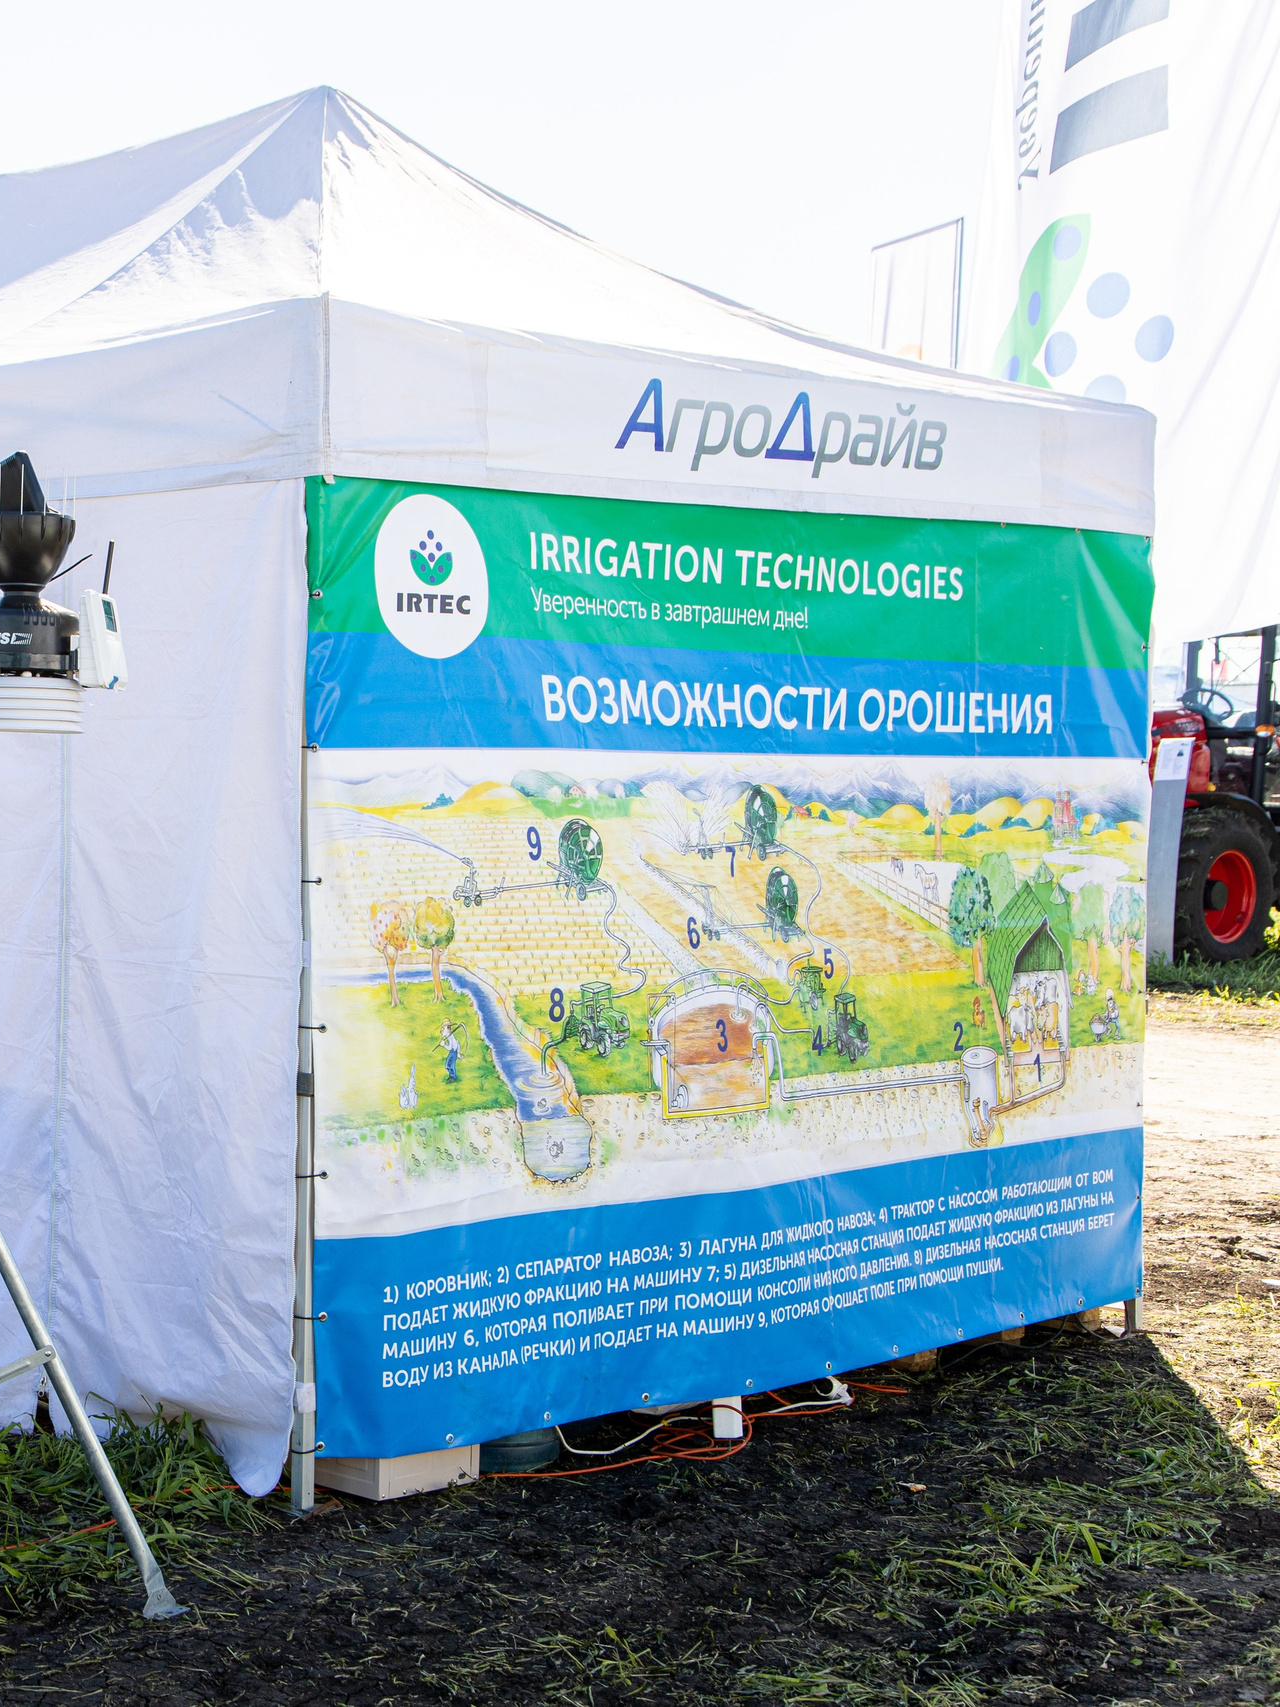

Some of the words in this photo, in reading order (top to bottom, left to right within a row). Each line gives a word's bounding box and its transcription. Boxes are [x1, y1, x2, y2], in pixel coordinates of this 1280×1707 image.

[614, 378, 947, 478] АгроДрайв
[530, 532, 723, 584] IRRIGATION
[735, 549, 963, 601] TECHNOLOGIES
[396, 592, 471, 615] IRTEC
[531, 586, 647, 620] Уверенность
[651, 606, 661, 621] в
[664, 607, 771, 629] завтрашнем
[773, 606, 809, 631] дне!
[541, 674, 847, 731] ВОЗМОЖНОСТИ
[858, 688, 1053, 735] ОРОШЕНИЯ
[527, 827, 542, 861] 9
[725, 846, 736, 877] 7
[687, 917, 700, 949] 6
[823, 948, 834, 979] 5
[549, 988, 564, 1022] 8
[716, 1019, 728, 1052] 3
[812, 1025, 823, 1056] 4
[954, 1022, 963, 1051] 2
[1034, 1054, 1041, 1082] 1
[383, 1285, 399, 1305] 1)
[406, 1269, 492, 1301] КОРОВНИК;
[497, 1265, 510, 1284] 2)
[515, 1252, 602, 1280] СЕПАРАТОР
[609, 1244, 672, 1267] НАВОЗА;
[679, 1240, 692, 1259] 3)
[698, 1234, 757, 1256] ЛАГУНА
[760, 1229, 784, 1251] ДЛЯ
[785, 1218, 834, 1243] ЖИДКОГО
[837, 1210, 876, 1232] НАВОЗА;
[878, 1207, 888, 1224] 4)
[890, 1198, 935, 1220] ТРАКТОР
[937, 1196, 946, 1212] С
[948, 1187, 998, 1210] НАСОСОМ
[1001, 1175, 1072, 1200] РАБОТАЮЩИМ
[1075, 1172, 1090, 1188] ОТ
[1092, 1168, 1114, 1185] ВОМ
[383, 1304, 449, 1332] ПОДАЕТ
[452, 1292, 521, 1320] ЖИДКУЮ
[524, 1279, 602, 1306] ФРАКЦИЮ
[607, 1276, 630, 1294] НА
[633, 1266, 703, 1291] МАШИНУ
[706, 1265, 720, 1283] 7;
[724, 1263, 737, 1281] 5)
[739, 1250, 806, 1281] ДИЗЕЛЬНАЯ
[807, 1238, 860, 1265] НАСОСНАЯ
[861, 1228, 905, 1252] СТАНЦИЯ
[906, 1220, 947, 1242] ПОДАЕТ
[948, 1212, 993, 1234] ЖИДКУЮ
[994, 1202, 1045, 1225] ФРАКЦИЮ
[1046, 1200, 1059, 1215] ИЗ
[1060, 1193, 1099, 1213] ЛАГУНЫ
[1100, 1190, 1115, 1206] НА
[382, 1331, 457, 1360] МАШИНУ
[463, 1329, 479, 1347] 6,
[484, 1314, 547, 1343] КОТОРАЯ
[553, 1302, 635, 1329] ПОЛИВАЕТ
[639, 1296, 668, 1316] ПРИ
[674, 1287, 752, 1311] ПОМОЩИ
[757, 1275, 811, 1302] КОНСОЛИ
[813, 1264, 858, 1289] НИЗКОГО
[859, 1252, 910, 1281] ДАВЛЕНИЯ.
[913, 1249, 923, 1266] 8)
[925, 1237, 981, 1265] ДИЗЕЛЬНАЯ
[984, 1226, 1038, 1250] НАСОСНАЯ
[1039, 1217, 1086, 1239] СТАНЦИЯ
[1087, 1211, 1116, 1230] БЕРЕТ
[382, 1364, 429, 1388] ВОДУ
[433, 1360, 453, 1380] ИЗ
[457, 1348, 519, 1376] КАНАЛА
[520, 1337, 576, 1365] (РЕЧКИ)
[579, 1335, 590, 1352] И
[594, 1324, 653, 1350] ПОДАЕТ
[656, 1321, 679, 1339] НА
[683, 1313, 755, 1336] МАШИНУ
[758, 1311, 769, 1331] 9,
[770, 1299, 820, 1325] КОТОРАЯ
[821, 1286, 869, 1313] ОРОШАЕТ
[870, 1280, 896, 1301] ПОЛЕ
[897, 1275, 918, 1294] ПРИ
[918, 1264, 965, 1289] ПОМОЩИ
[965, 1257, 1004, 1278] ПУШКИ.
